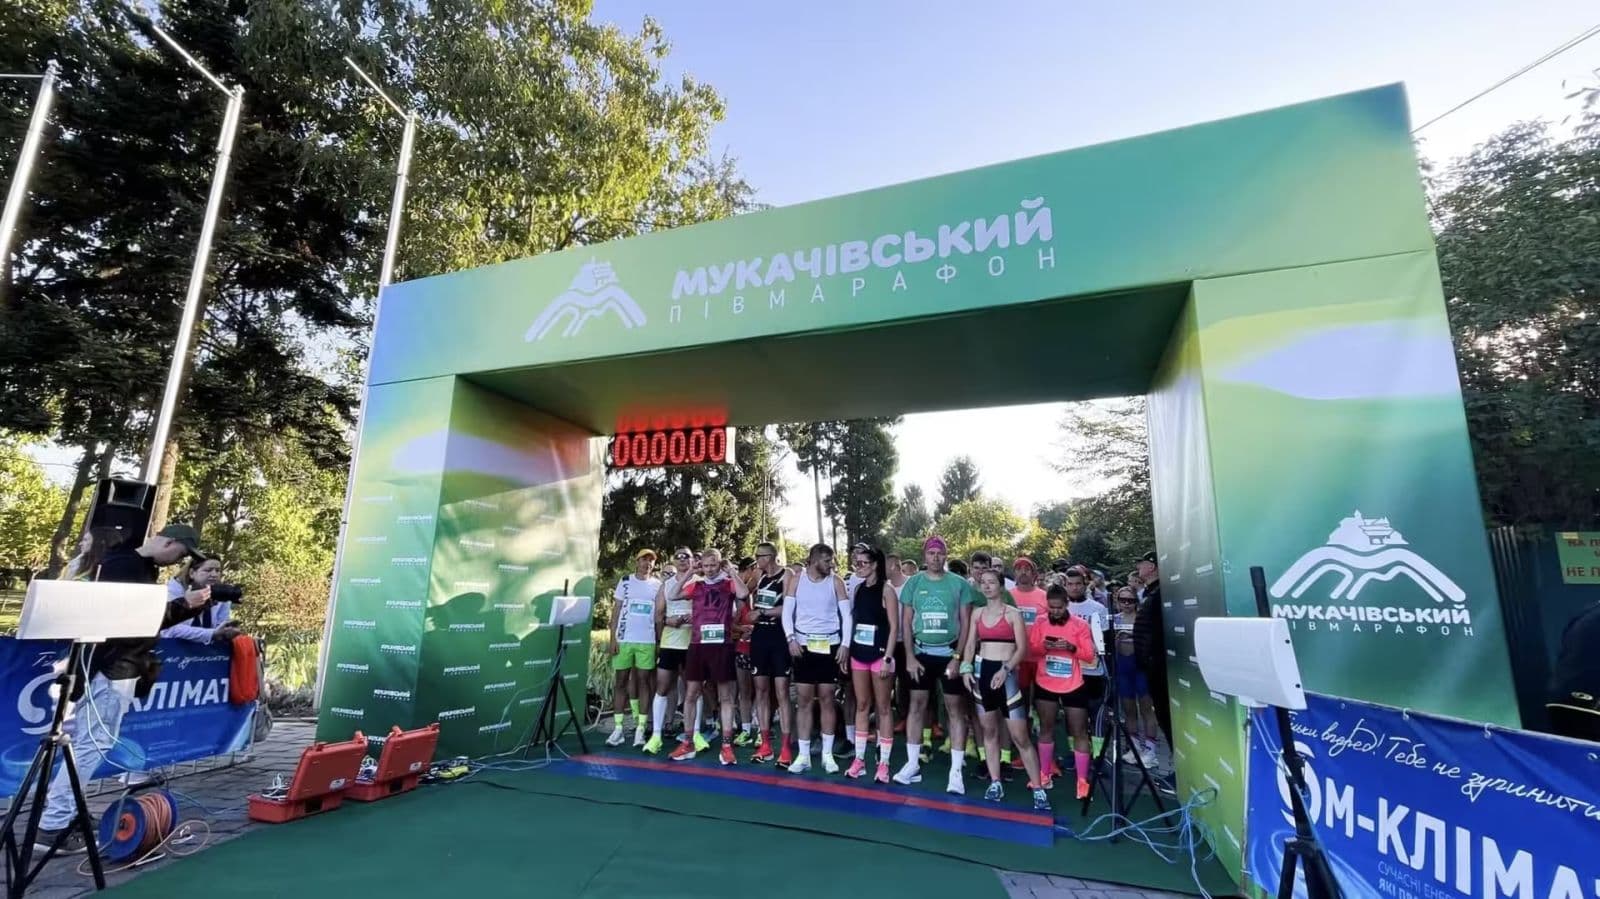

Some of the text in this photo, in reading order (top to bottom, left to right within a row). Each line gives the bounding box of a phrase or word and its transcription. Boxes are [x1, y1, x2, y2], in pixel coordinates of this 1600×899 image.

[671, 197, 1054, 299] МУКАЧІВСЬКИЙ
[669, 247, 1056, 323] ПІВМАРАФОН
[1272, 603, 1471, 624] МУКАЧІВСЬКИЙ
[1292, 620, 1474, 637] ІВМАРАФОН
[1385, 737, 1427, 769] Тебе
[1432, 762, 1461, 778] не
[1276, 741, 1600, 899] ОМ-КЛІМА
[1377, 860, 1421, 894] СУЧАСНІ
[1379, 877, 1396, 897] ЯКІ
